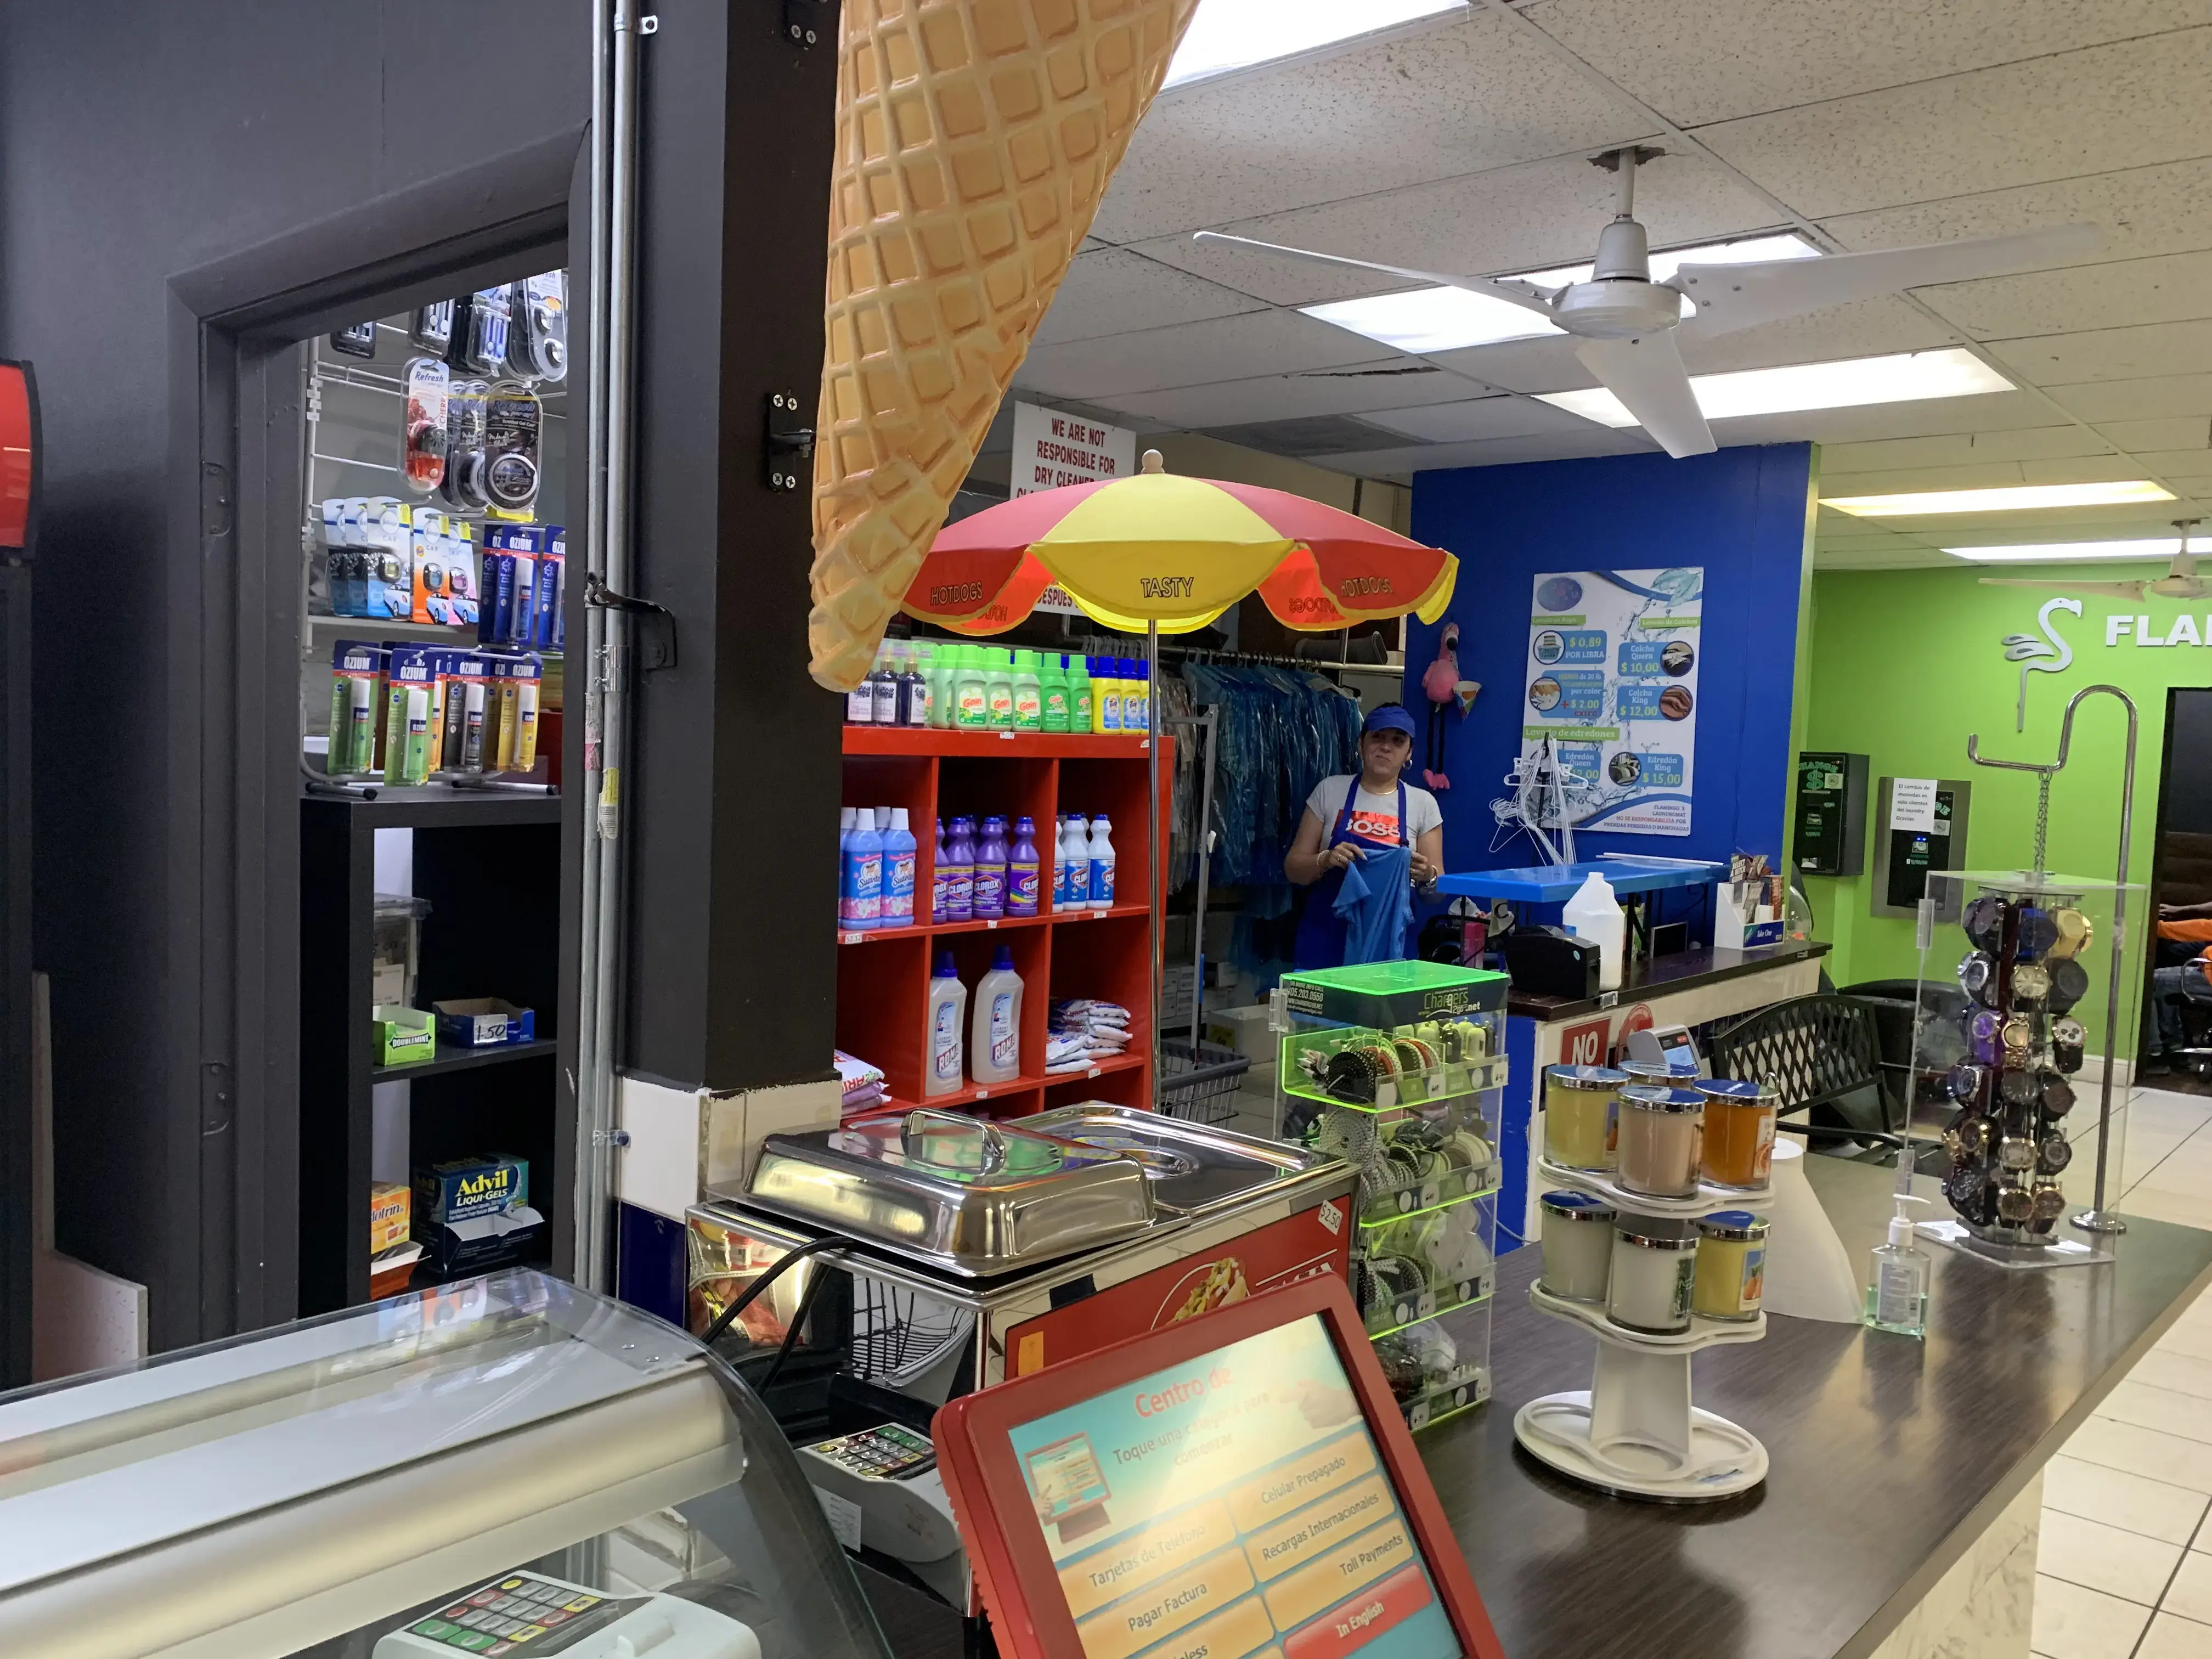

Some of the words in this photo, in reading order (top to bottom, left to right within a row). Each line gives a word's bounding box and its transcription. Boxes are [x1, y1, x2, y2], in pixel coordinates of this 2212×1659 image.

[415, 371, 444, 383] Refresh
[439, 392, 448, 424] CHERRY
[493, 400, 535, 412] Refresh
[1052, 417, 1065, 437] WE
[1068, 422, 1086, 443] ARE
[1088, 428, 1105, 448] NOT
[1037, 439, 1096, 470] RESPONSIBLE
[1099, 455, 1115, 475] FOR
[1035, 465, 1053, 486] DRY
[510, 536, 532, 551] OZIUM
[552, 540, 566, 555] OZIU
[930, 580, 983, 606] HOTDOGS
[1141, 577, 1194, 598] TASTY
[1341, 577, 1393, 598] HOTDOGS
[2106, 614, 2212, 647] FLA
[343, 656, 371, 670] OZIUM
[459, 661, 483, 675] OZIUM
[495, 663, 505, 675] OZI
[1630, 662, 1659, 674] 10,00
[400, 665, 427, 681] OZIUM
[512, 664, 535, 678] OZIUM
[963, 698, 983, 708] Gain
[994, 698, 1010, 710] Gain
[1019, 701, 1037, 712] Gain
[1632, 697, 1649, 706] King
[1630, 706, 1658, 718] 12,00
[1569, 759, 1591, 768] Queen
[1647, 756, 1678, 764] Edredón
[1799, 761, 1839, 774] HANGE
[1655, 764, 1672, 772] King
[1652, 773, 1681, 786] 15,00
[934, 881, 948, 893] ROX
[949, 880, 973, 894] CLOROX
[974, 878, 1000, 891] CLOROX
[1289, 987, 1324, 1002] 05.203.0550
[1424, 991, 1469, 1014] Chargers
[477, 1024, 506, 1041] 1.50
[392, 1034, 429, 1047] DOUBLEMINT
[1571, 1031, 1599, 1065] NO
[842, 1075, 865, 1092] ARI
[455, 1169, 509, 1197] Advil
[1321, 1203, 1340, 1228] $2.50
[1135, 1378, 1205, 1418] Centro
[1208, 1367, 1234, 1390] de
[1113, 1439, 1156, 1465] Toque
[1158, 1428, 1183, 1447] una
[1243, 1392, 1271, 1414] para
[1174, 1432, 1234, 1466] comenzar
[1261, 1481, 1296, 1504] Celular
[1296, 1457, 1346, 1487] Prepagado
[1262, 1530, 1308, 1561] Recargas
[1308, 1492, 1379, 1537] Internacionales
[1339, 1556, 1359, 1576] Toll
[1358, 1534, 1404, 1565] Payments
[1089, 1556, 1140, 1588] Tarjetas
[1141, 1548, 1156, 1563] de
[1128, 1606, 1163, 1632] Pagar
[1164, 1583, 1207, 1613] Factura
[1335, 1622, 1350, 1639] In
[1349, 1601, 1385, 1630] English
